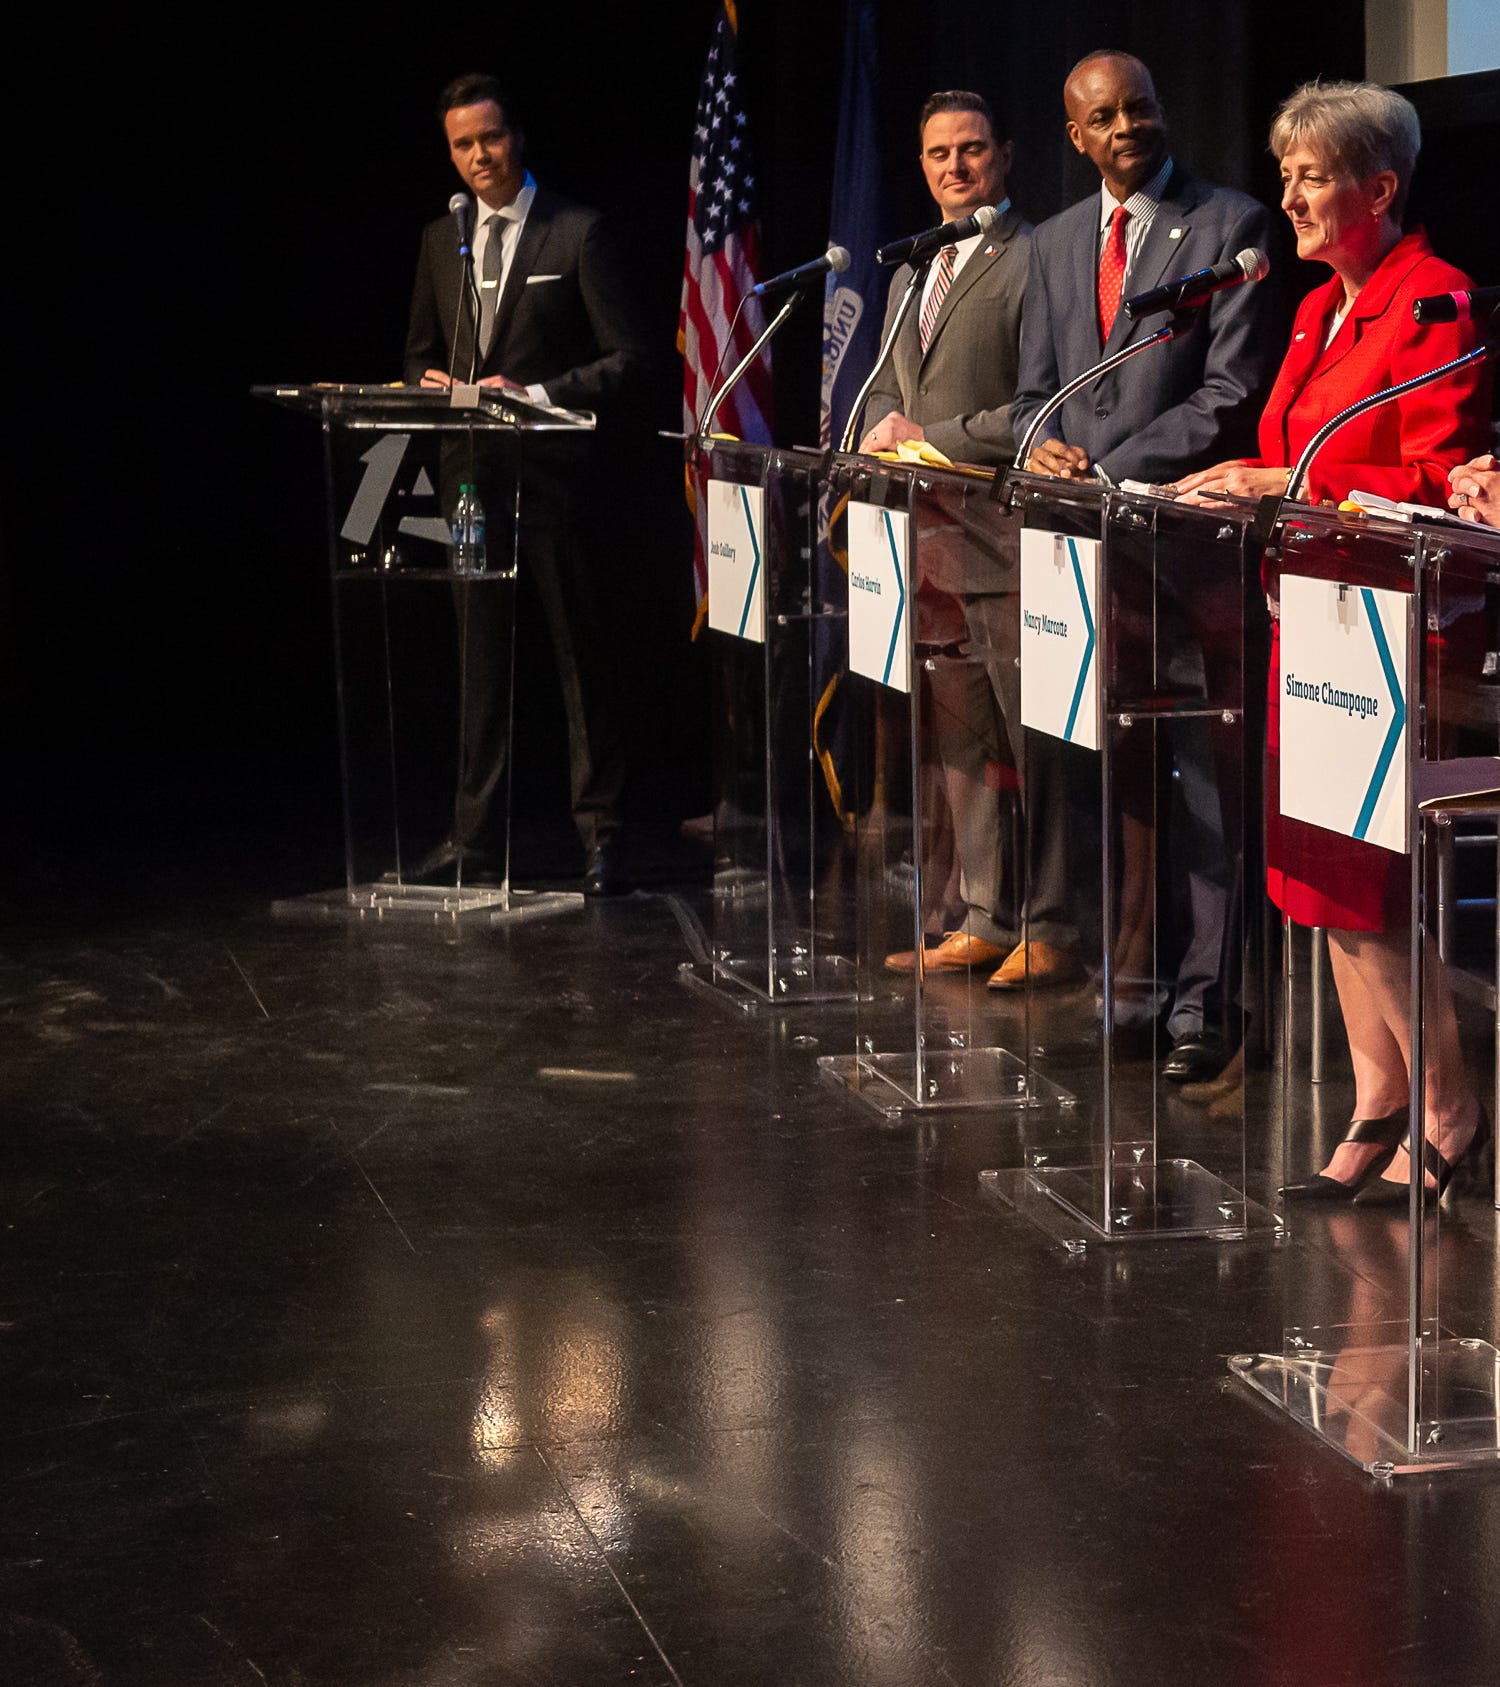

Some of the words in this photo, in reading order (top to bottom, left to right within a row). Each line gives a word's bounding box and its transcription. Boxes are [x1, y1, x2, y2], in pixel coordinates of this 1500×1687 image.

[1042, 614, 1067, 638] Marcotte
[1286, 673, 1320, 702] Simone
[1321, 682, 1378, 719] Champagne
